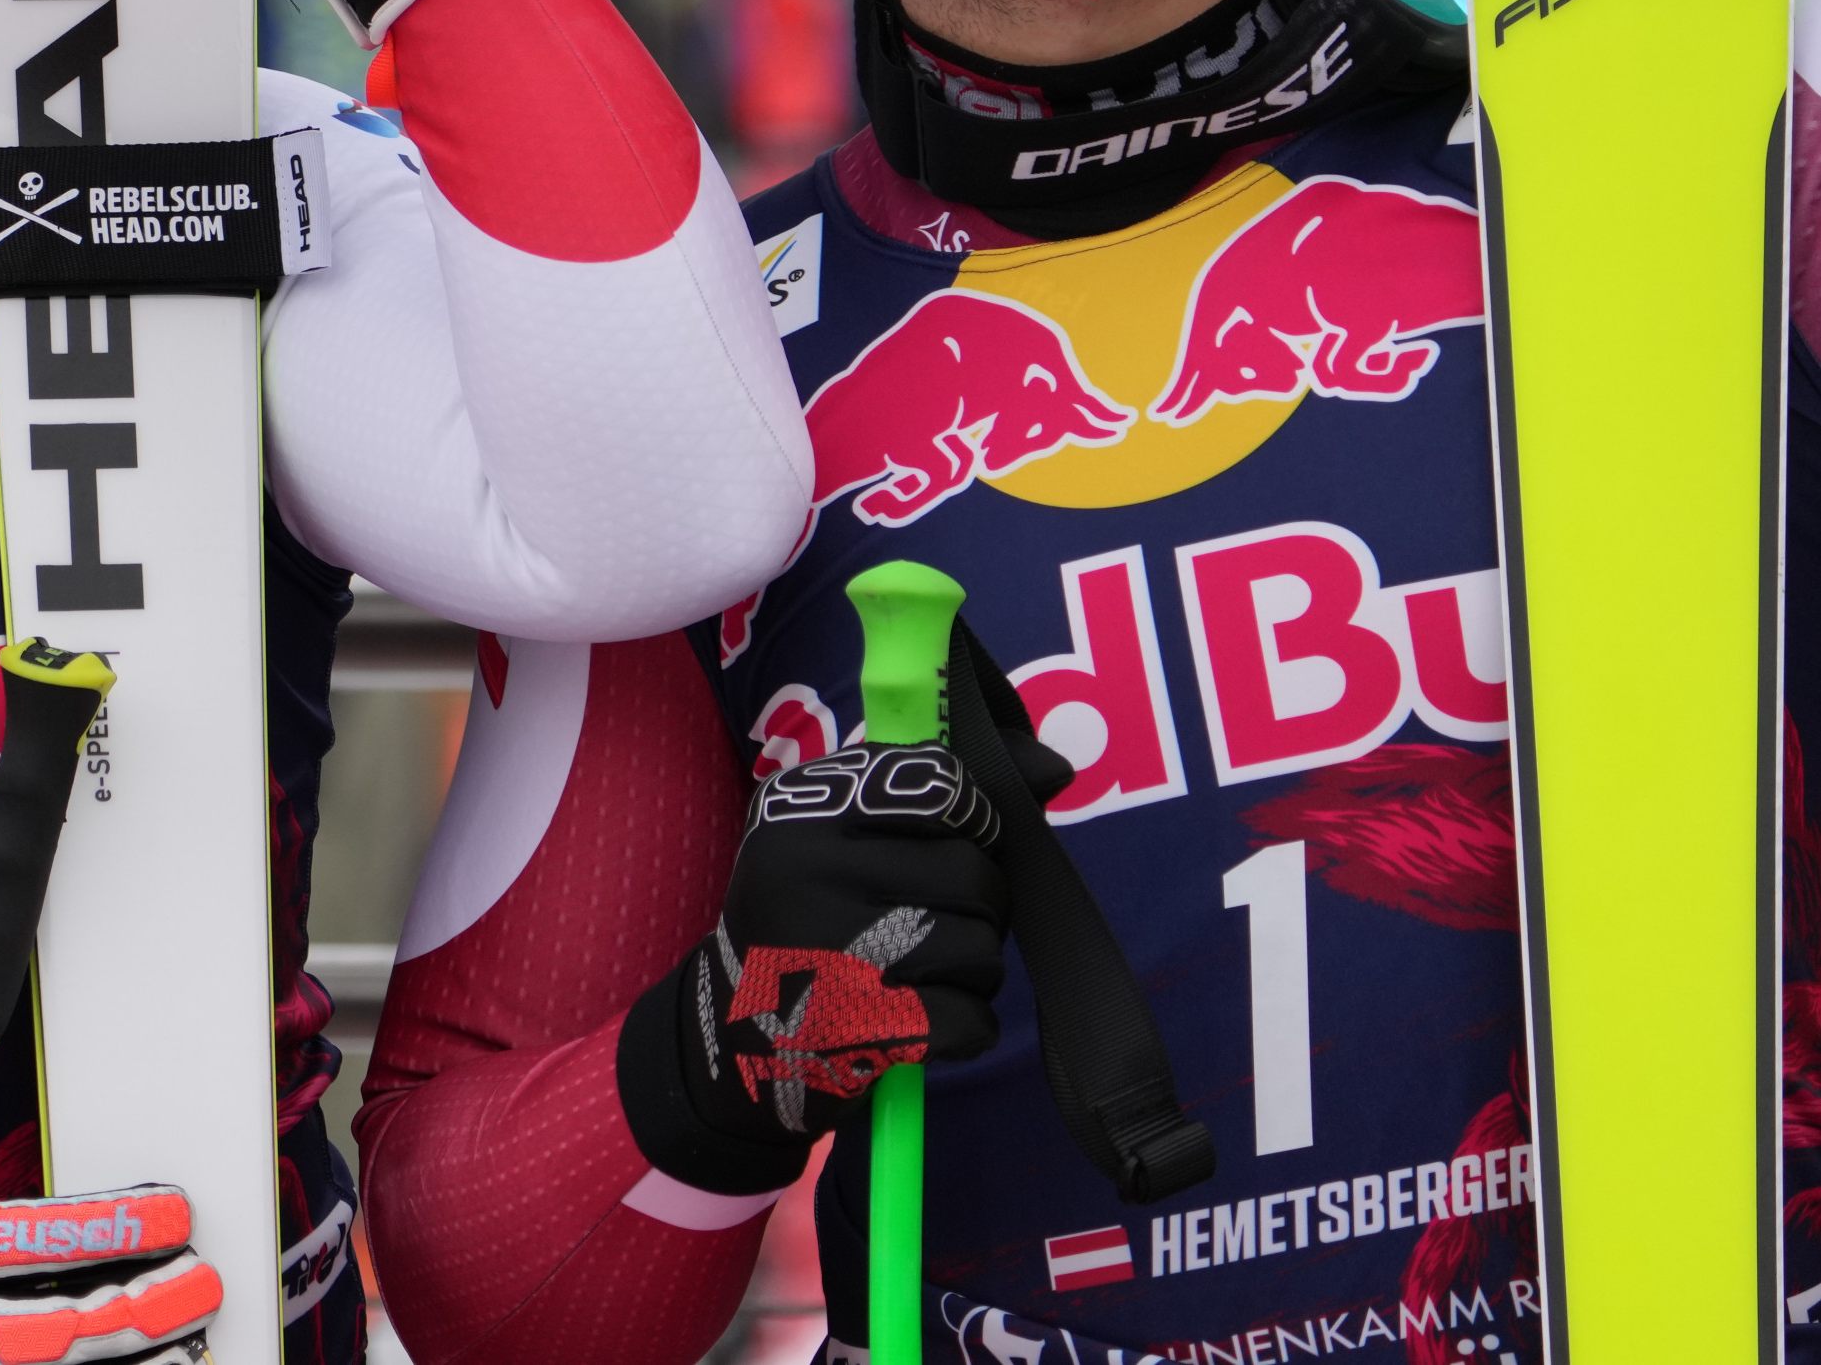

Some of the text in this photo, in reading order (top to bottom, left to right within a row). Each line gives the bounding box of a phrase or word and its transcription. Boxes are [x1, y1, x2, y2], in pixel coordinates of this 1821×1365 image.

[1011, 21, 1353, 180] DAINESE
[89, 184, 258, 214] REBELSCLUB.
[91, 215, 225, 244] HEAD.COM
[290, 154, 311, 252] HEAD
[1221, 841, 1313, 1156] 1
[1151, 1143, 1536, 1278] HEMETSBERGER
